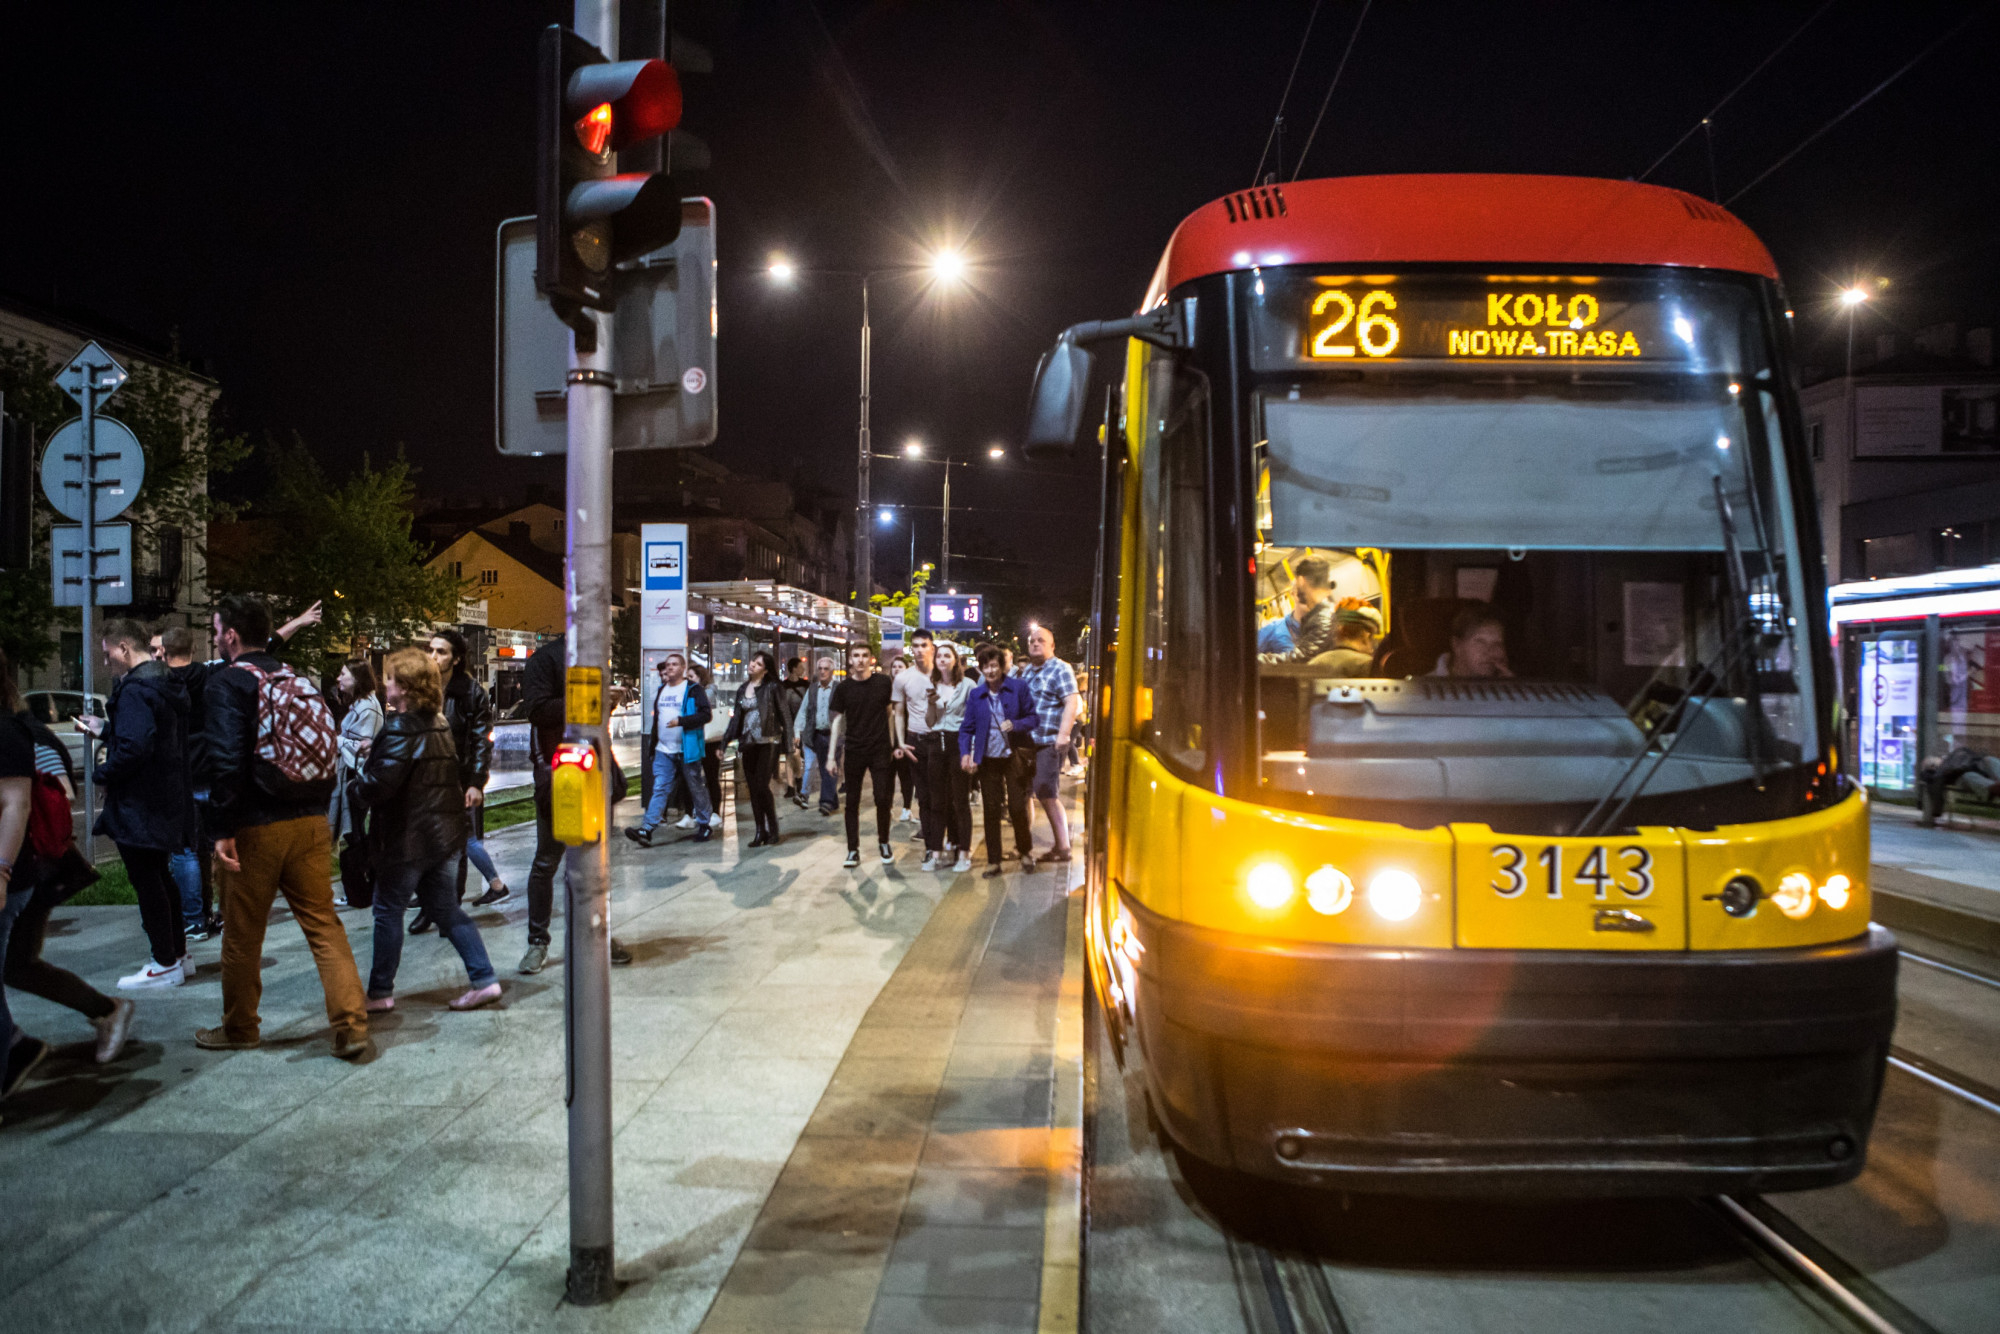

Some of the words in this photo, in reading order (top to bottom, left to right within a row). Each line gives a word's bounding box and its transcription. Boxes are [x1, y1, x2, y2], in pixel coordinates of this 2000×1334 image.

[1312, 291, 1399, 357] 26
[1487, 293, 1600, 327] KOŁO
[1448, 330, 1536, 356] NOWA
[1544, 331, 1641, 356] TRASA
[1490, 844, 1654, 900] 3143
